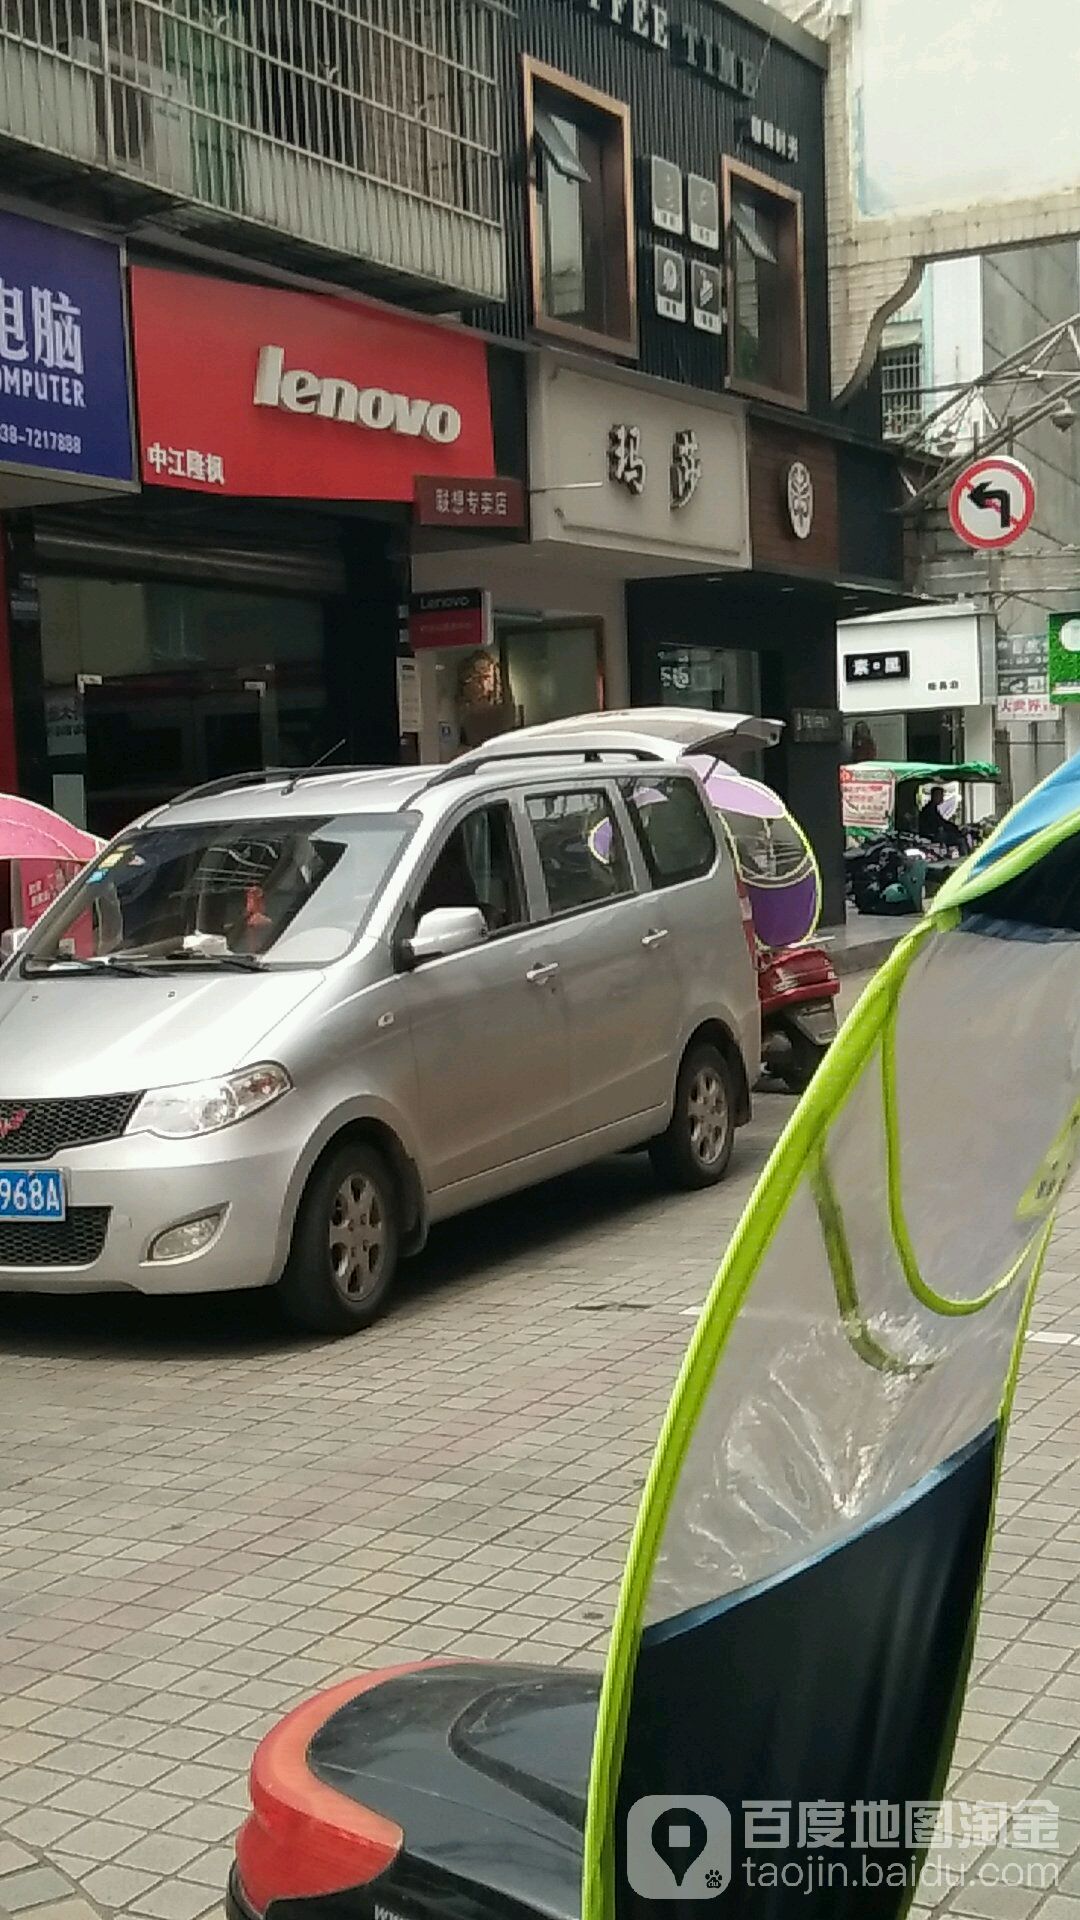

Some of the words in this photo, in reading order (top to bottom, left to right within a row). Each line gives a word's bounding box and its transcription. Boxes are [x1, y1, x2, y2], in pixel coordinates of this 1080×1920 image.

[681, 22, 759, 98] TIME
[253, 345, 461, 444] lenovo
[147, 441, 225, 485] 中江隆枫
[420, 596, 470, 610] Lenovo
